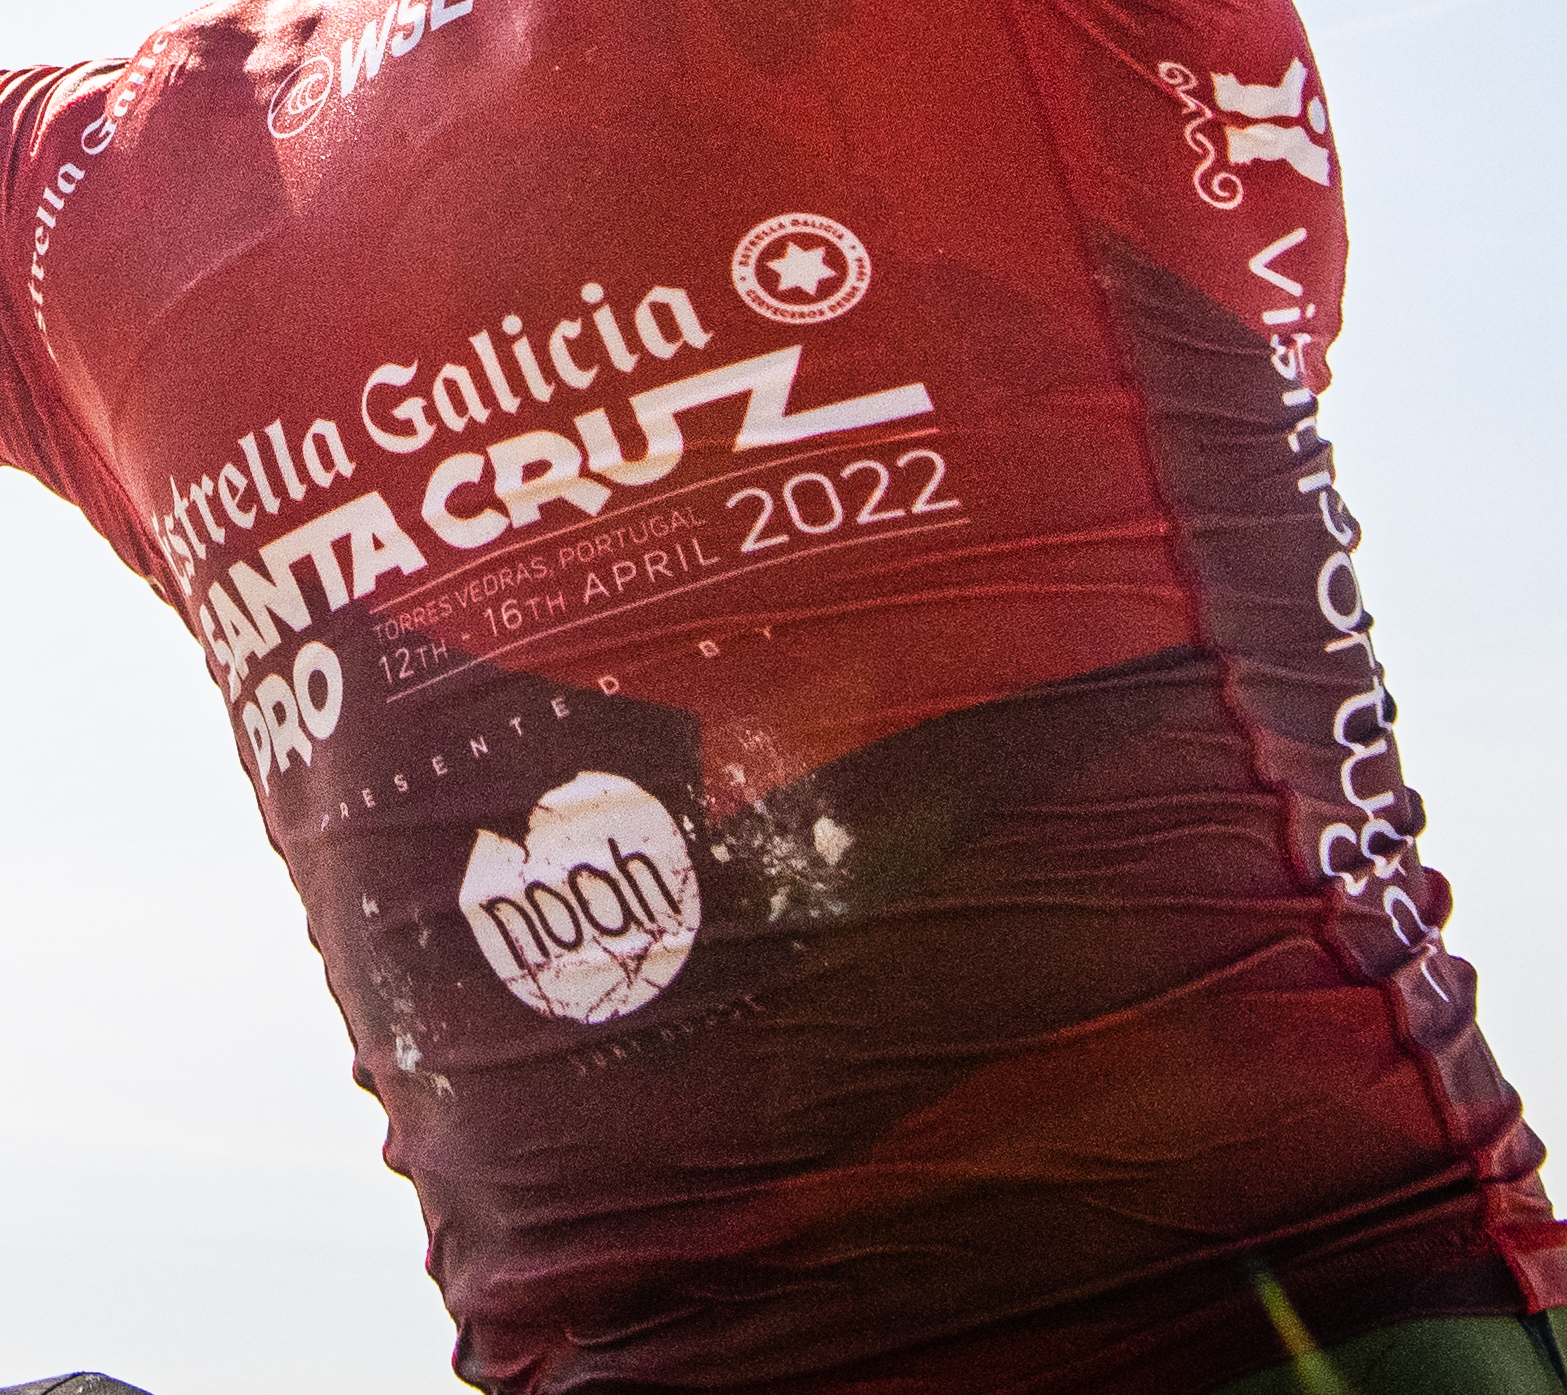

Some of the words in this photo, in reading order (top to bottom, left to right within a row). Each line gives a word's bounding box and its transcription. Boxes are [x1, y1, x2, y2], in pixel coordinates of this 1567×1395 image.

[361, 281, 716, 454] Galicia
[199, 490, 429, 704] SANTA
[421, 344, 935, 551] CRUZ
[372, 595, 453, 645] TORRES
[558, 509, 707, 567] PORTUGAL
[378, 641, 450, 685] 12TH
[483, 591, 566, 637] 16TH
[582, 536, 720, 605] APRIL
[726, 448, 962, 554] 2022
[241, 641, 344, 798] PRO
[478, 837, 683, 973] noah
